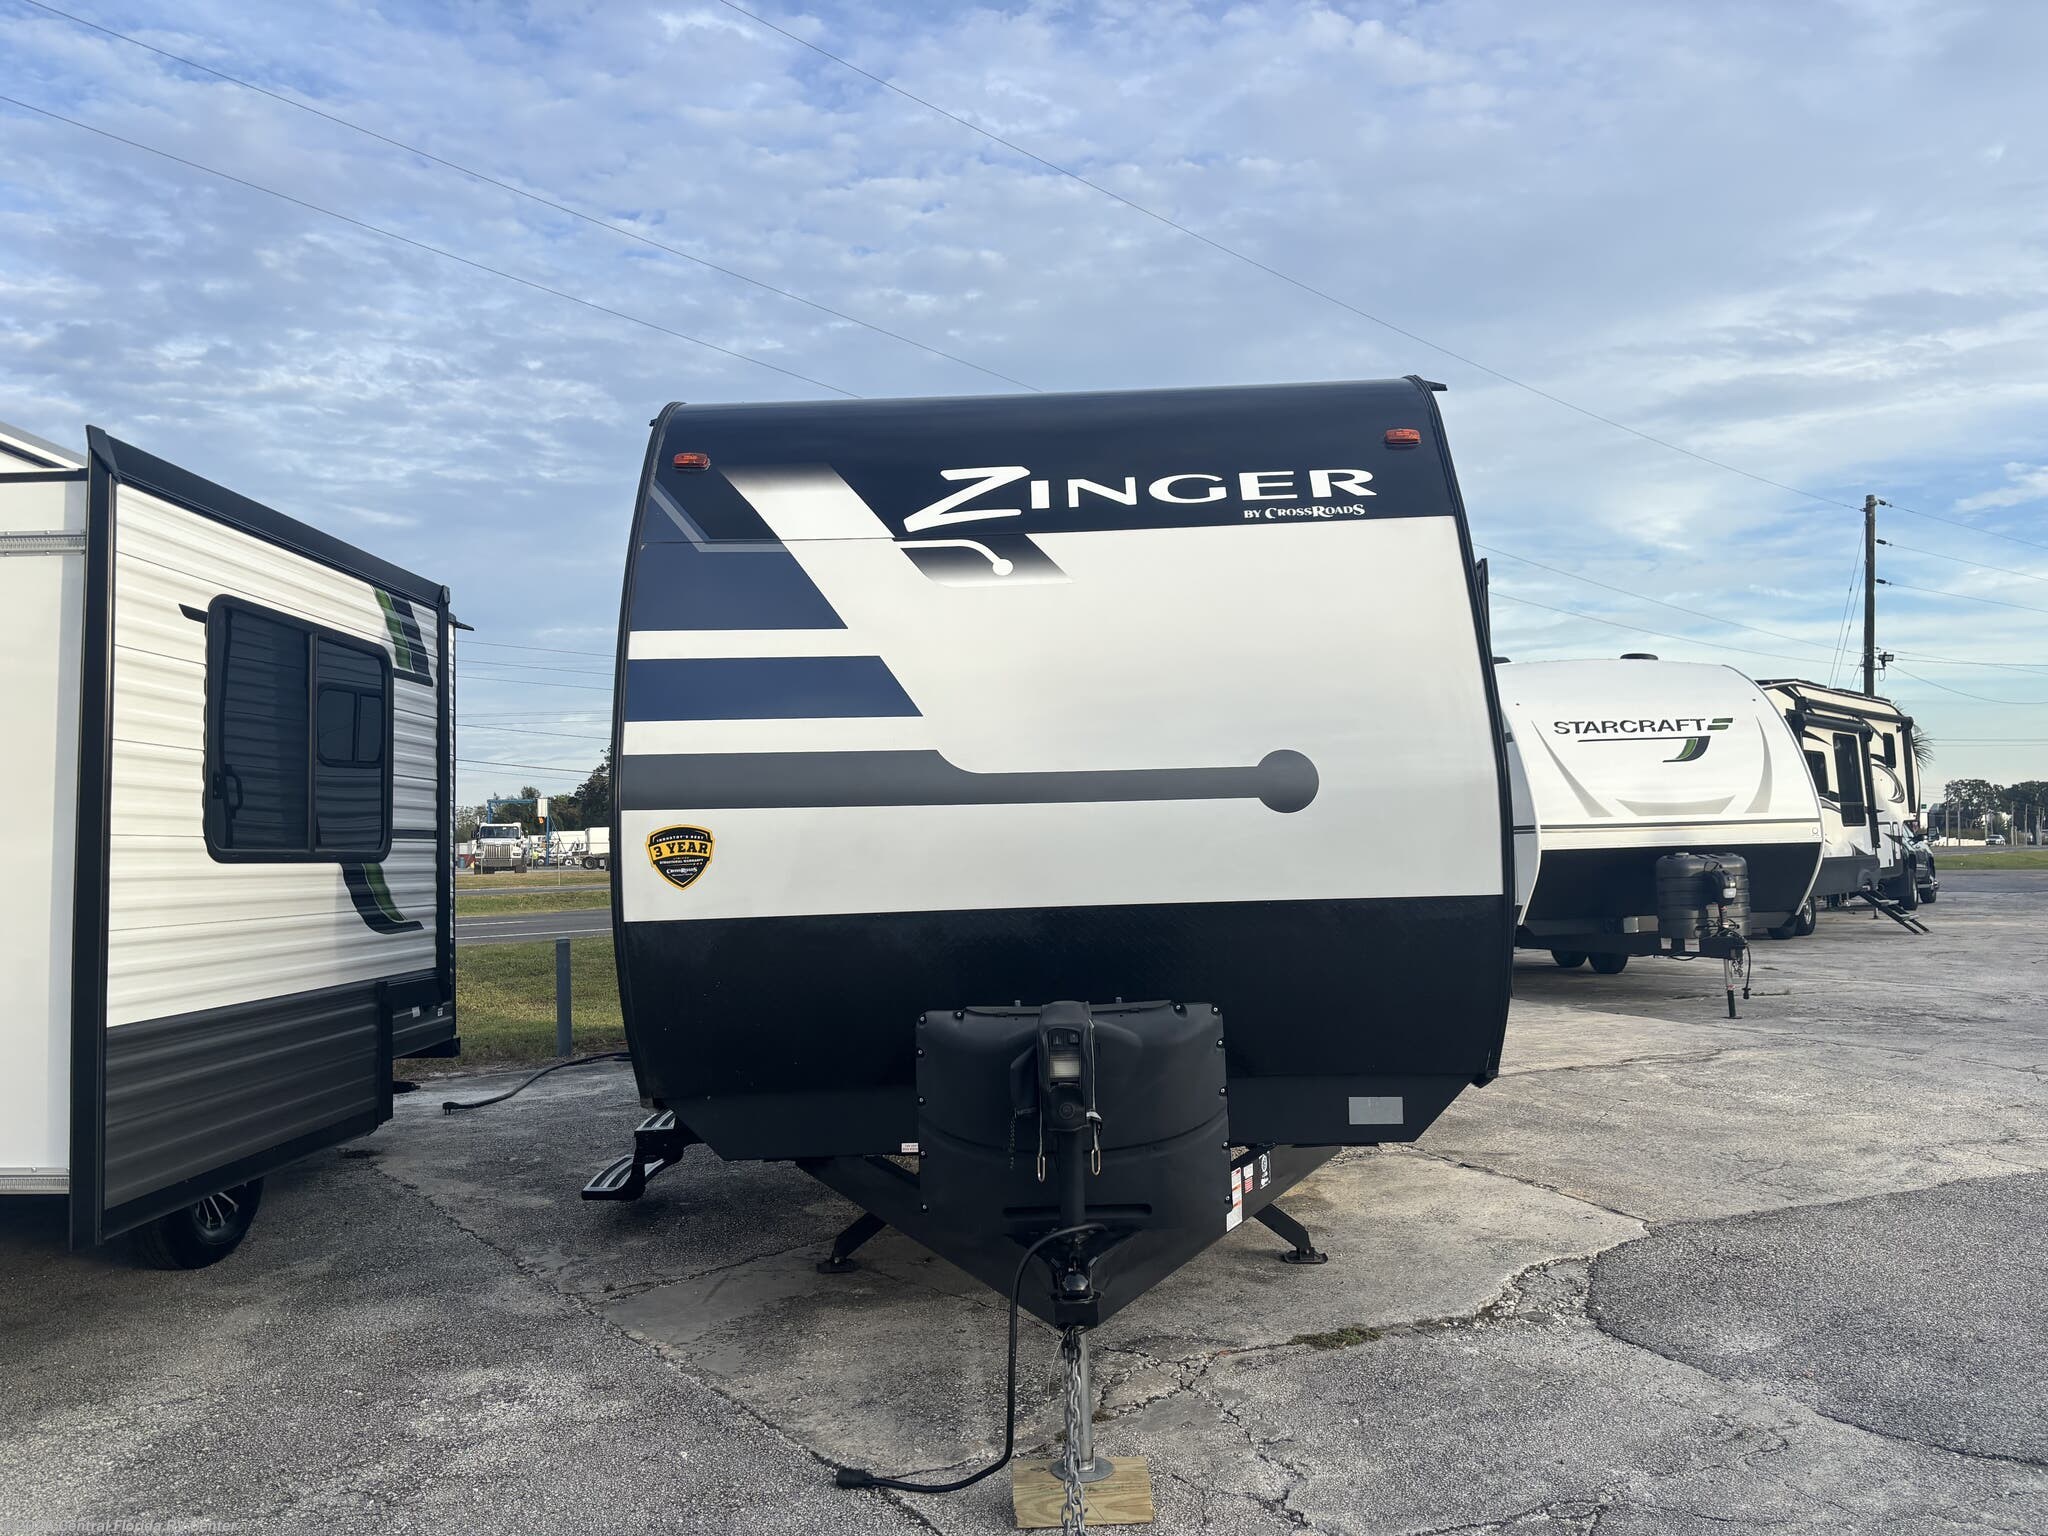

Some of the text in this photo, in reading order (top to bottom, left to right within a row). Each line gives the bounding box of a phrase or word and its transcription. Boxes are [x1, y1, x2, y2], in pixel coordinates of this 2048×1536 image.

[903, 465, 1378, 533] ZINGER
[1243, 503, 1366, 520] BY CROSSROADS
[1553, 717, 1706, 735] STARCRAFT
[654, 842, 708, 857] 3 YEAR
